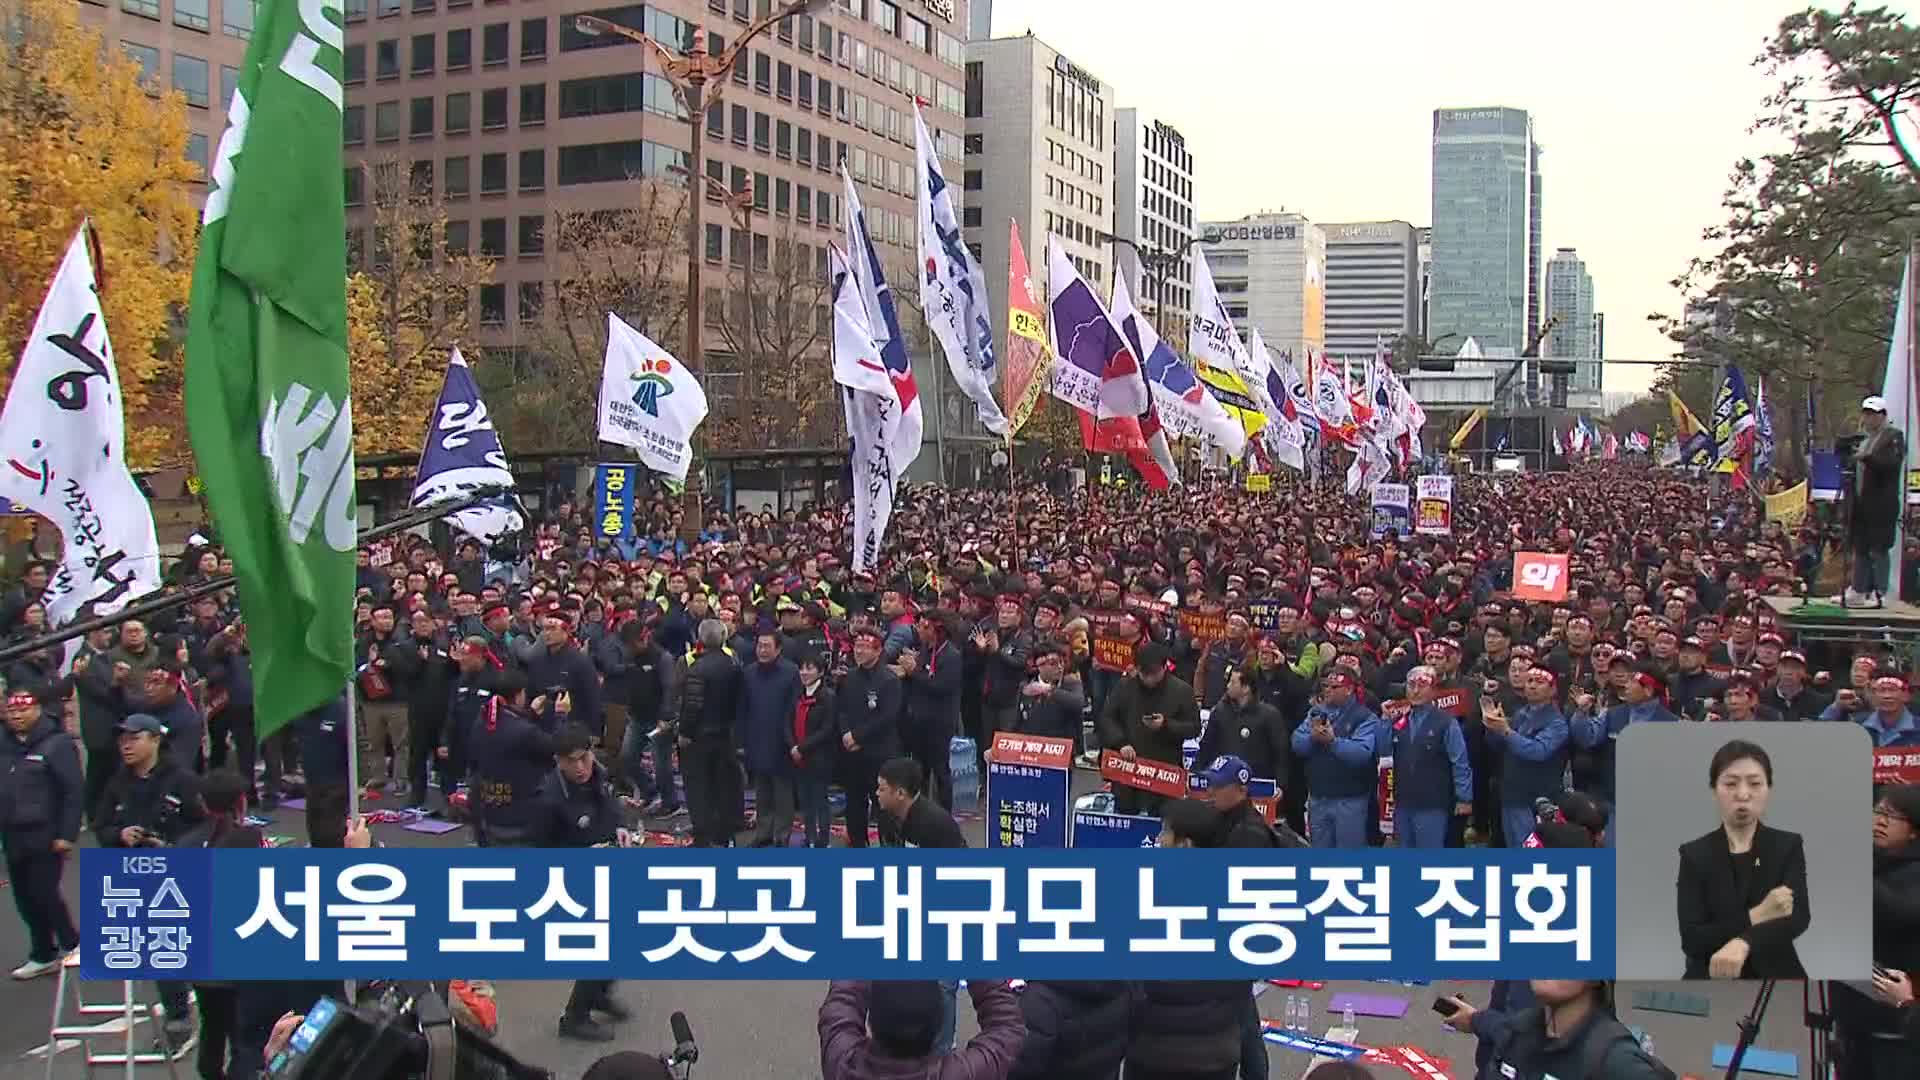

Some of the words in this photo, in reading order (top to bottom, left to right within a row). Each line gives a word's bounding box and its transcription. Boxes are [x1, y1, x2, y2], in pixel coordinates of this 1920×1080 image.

[1220, 226, 1296, 240] KDB산업은행
[603, 469, 625, 536] 공노총
[1000, 800, 1049, 820] 노조해서
[1000, 815, 1037, 834] 확실한
